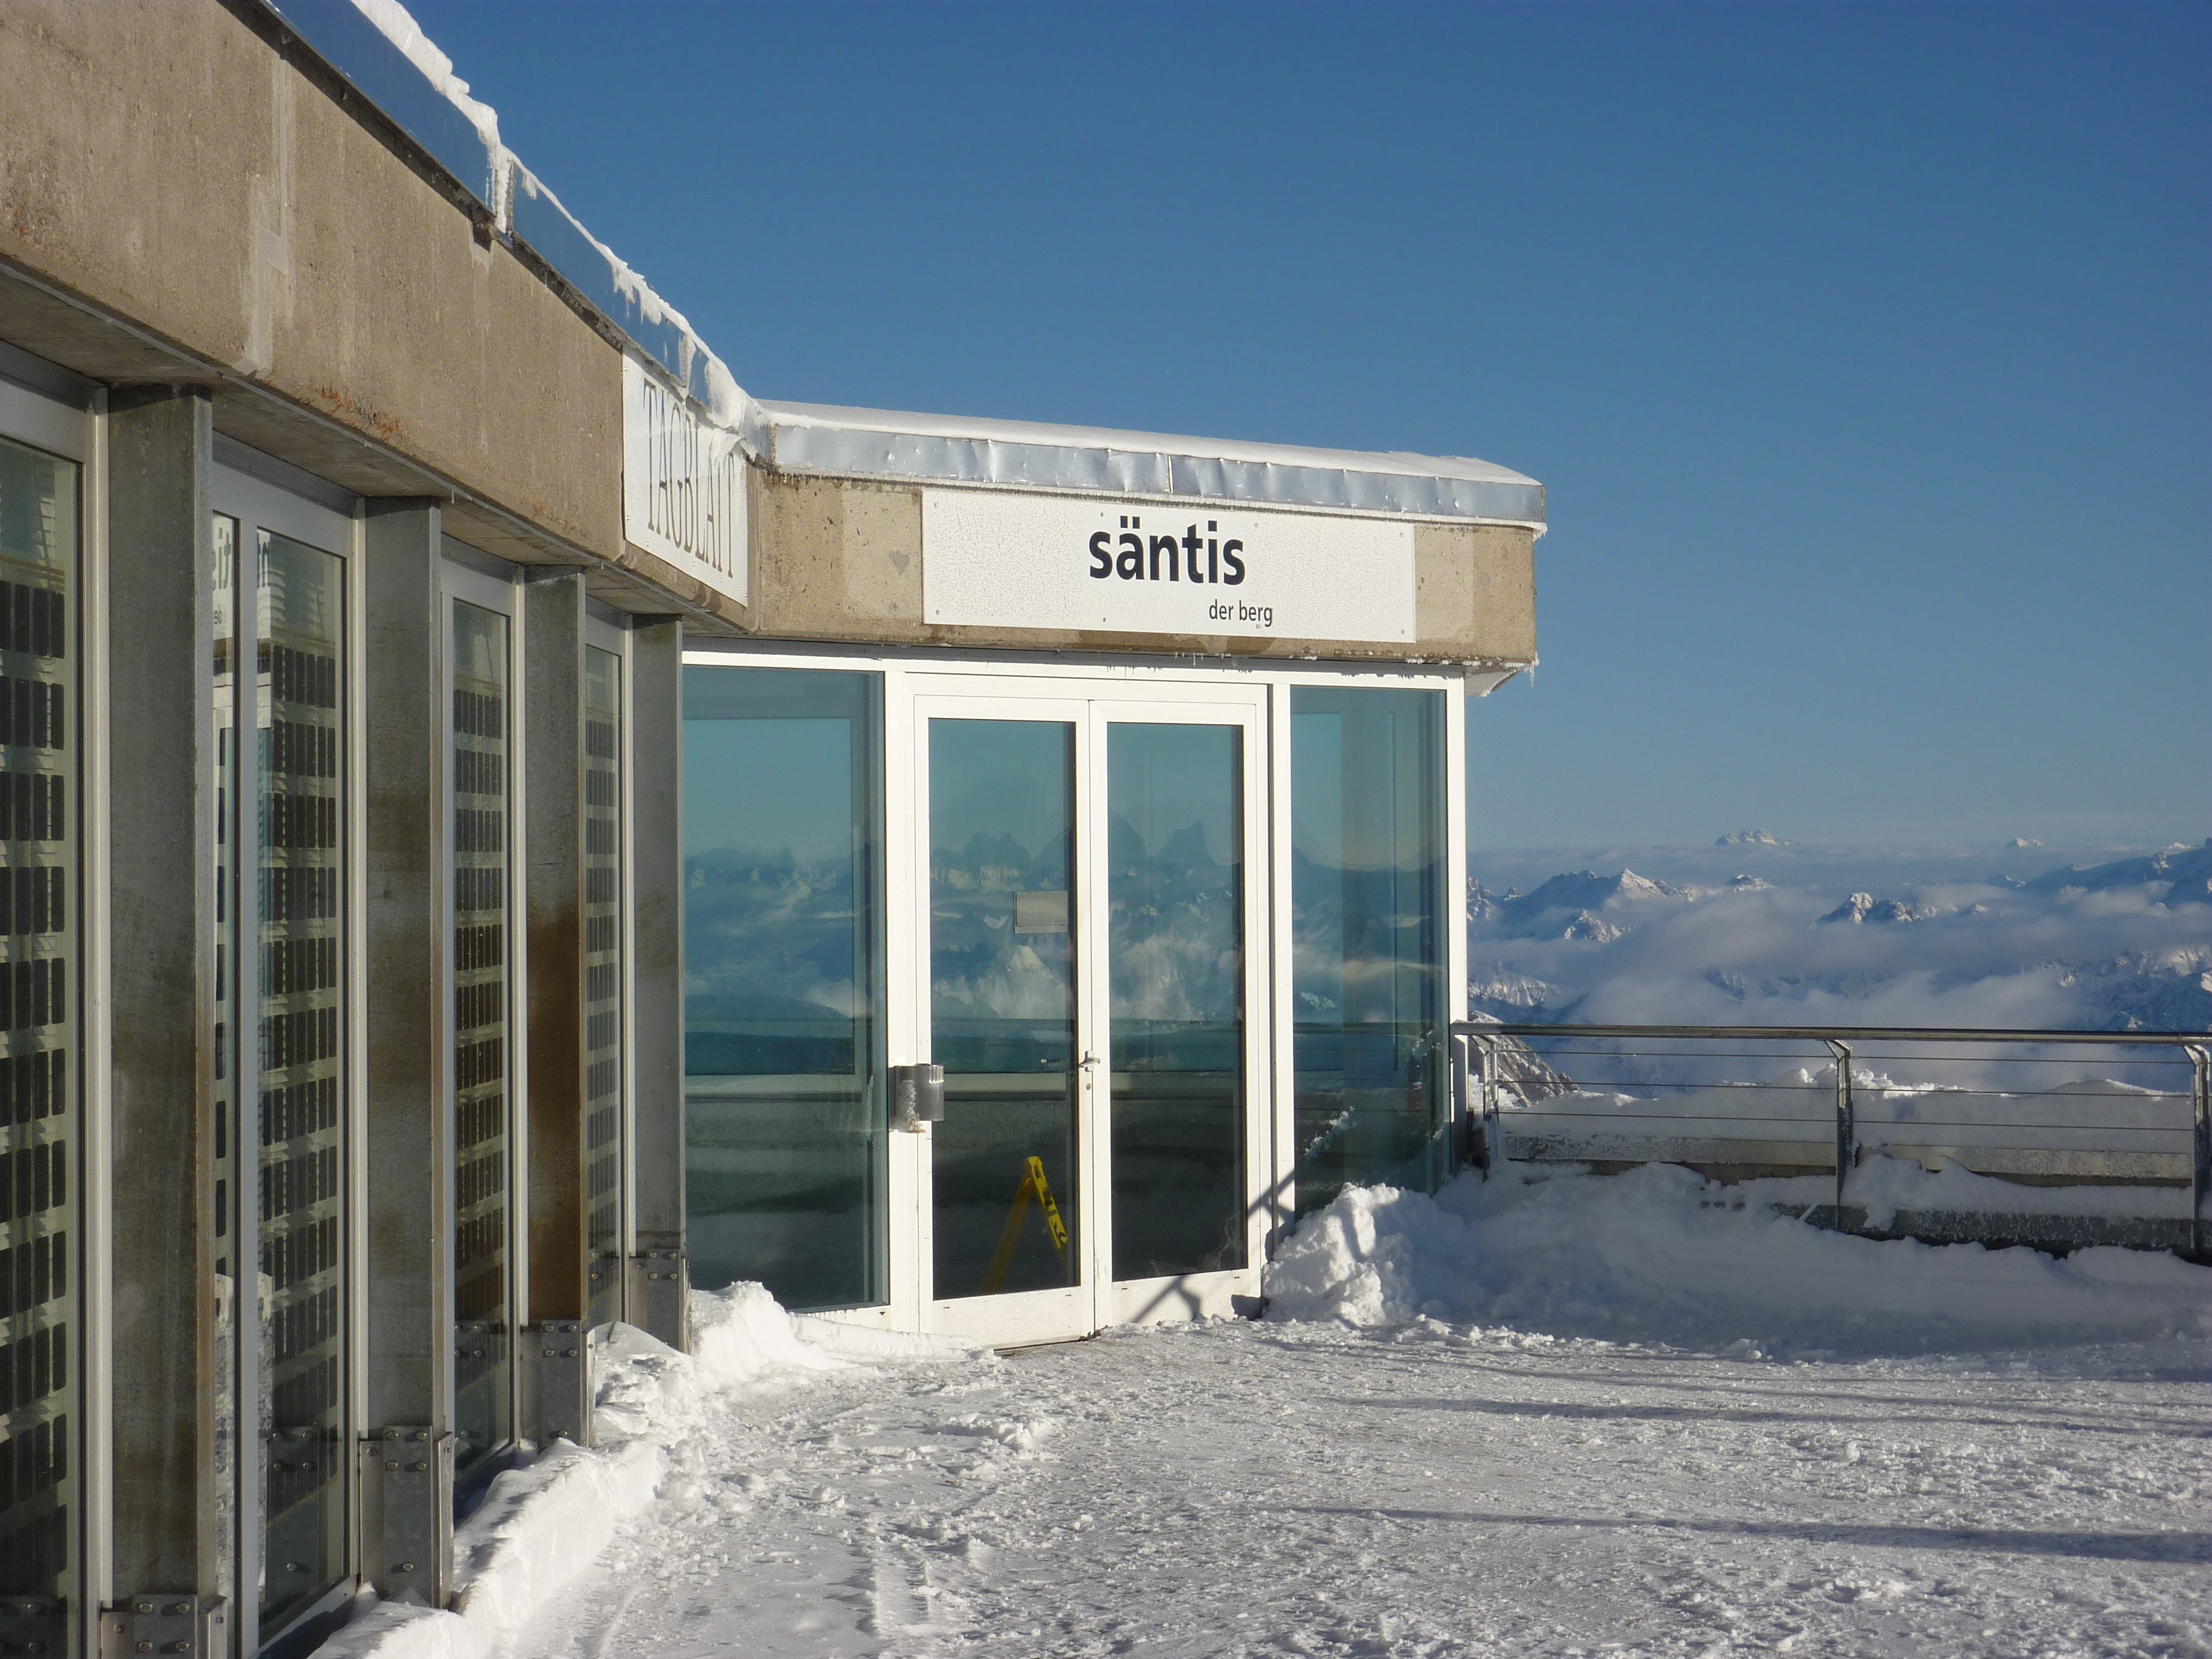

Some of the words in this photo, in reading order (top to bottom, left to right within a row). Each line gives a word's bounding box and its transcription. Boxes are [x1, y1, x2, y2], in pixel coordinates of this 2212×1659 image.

[1089, 515, 1245, 585] säntis
[1209, 598, 1234, 620] der
[1239, 600, 1273, 628] berg
